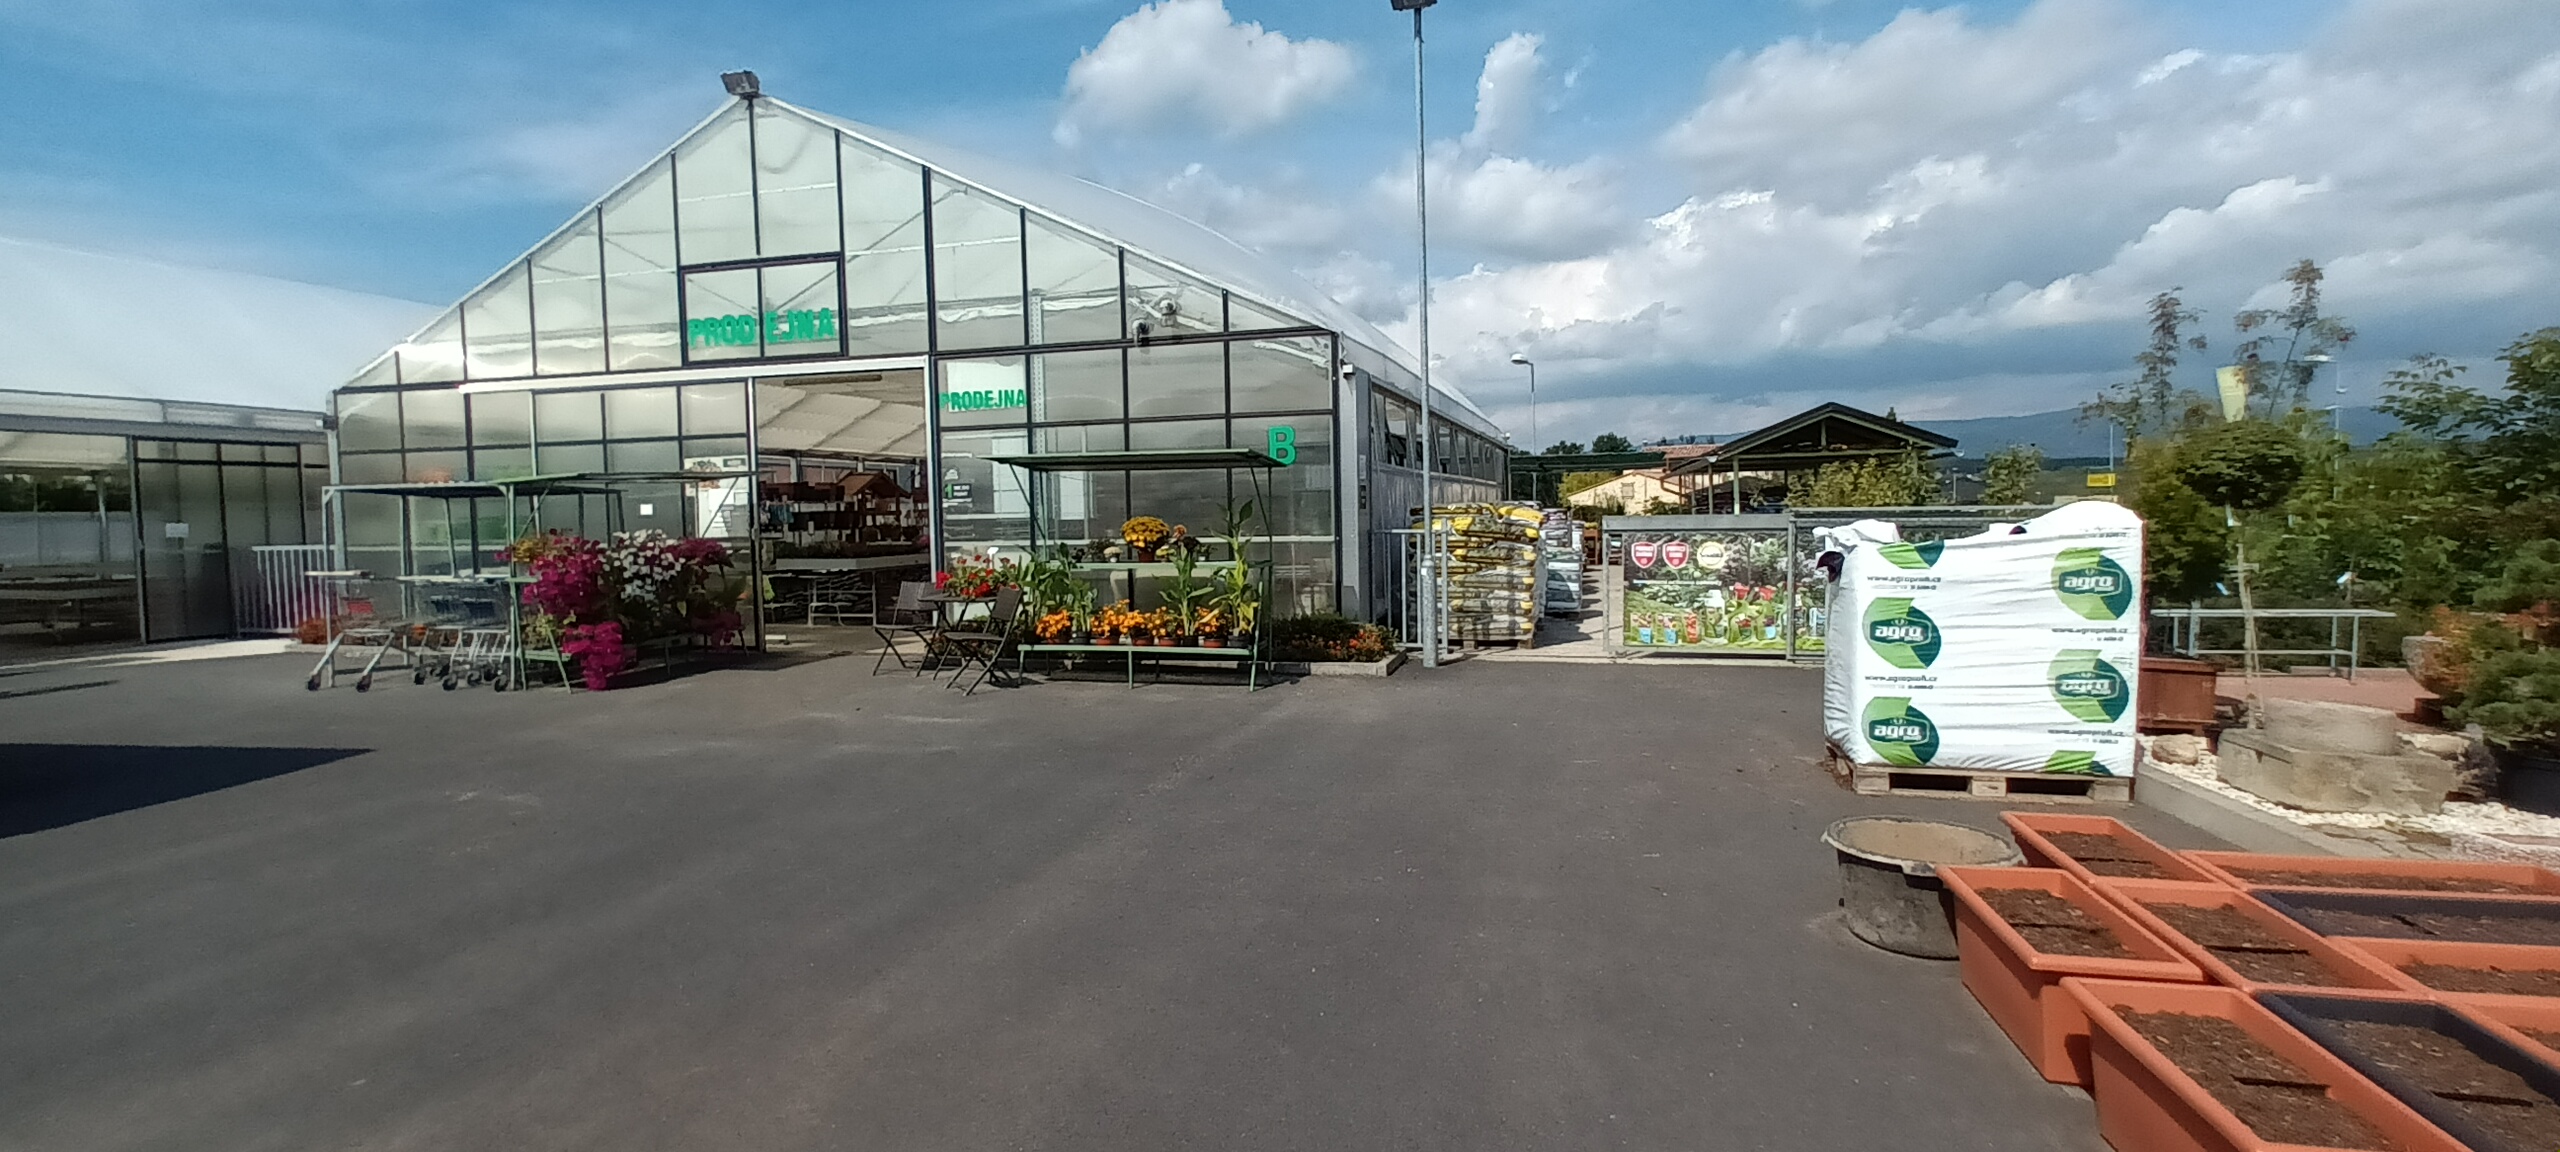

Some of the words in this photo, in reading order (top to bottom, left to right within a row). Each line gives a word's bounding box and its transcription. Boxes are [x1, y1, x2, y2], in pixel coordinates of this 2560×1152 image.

[939, 389, 1027, 411] PRODEJNA
[1268, 425, 1297, 465] B
[2063, 575, 2114, 591] agro
[1874, 625, 1921, 640] agro
[1873, 725, 1920, 739] agro
